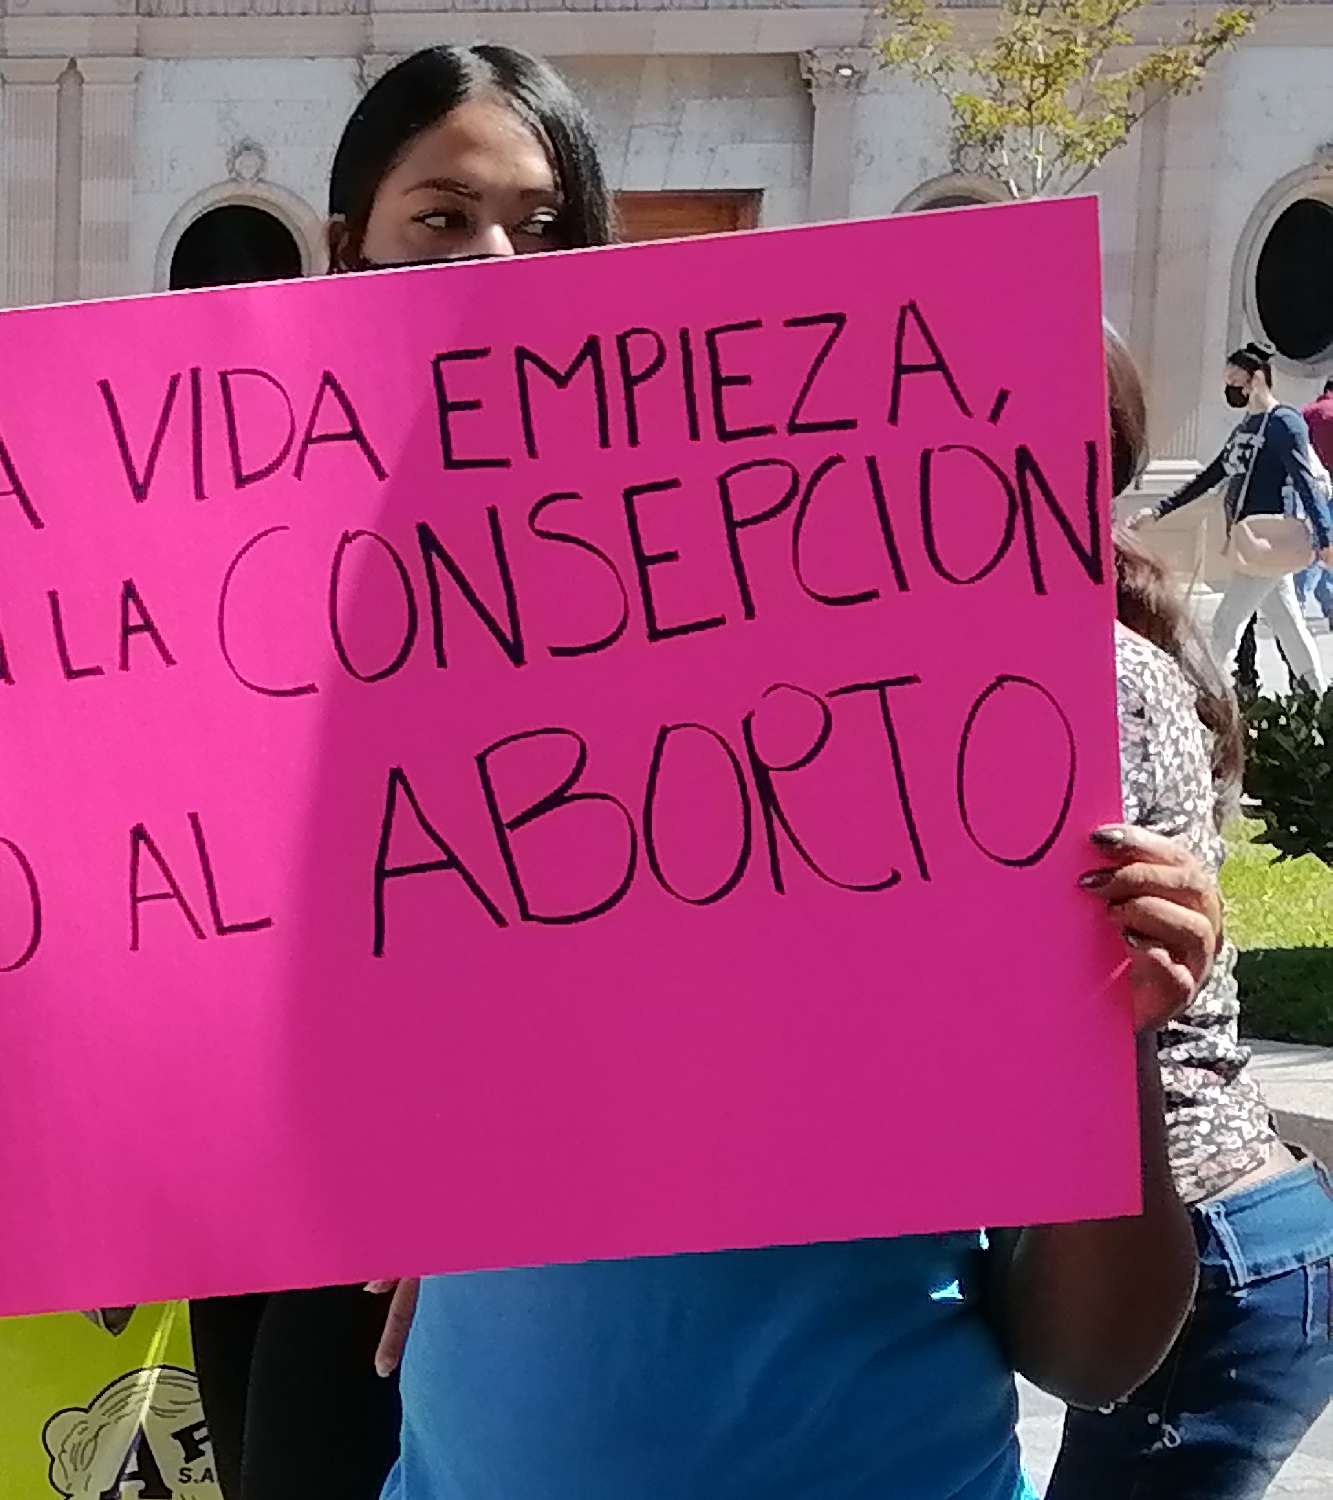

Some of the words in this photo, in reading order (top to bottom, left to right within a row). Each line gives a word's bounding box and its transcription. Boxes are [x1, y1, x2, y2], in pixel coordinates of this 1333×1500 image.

[100, 370, 388, 502] VIDA
[50, 578, 179, 682] LA
[130, 812, 273, 951] AL
[371, 674, 1077, 958] ABORTO
